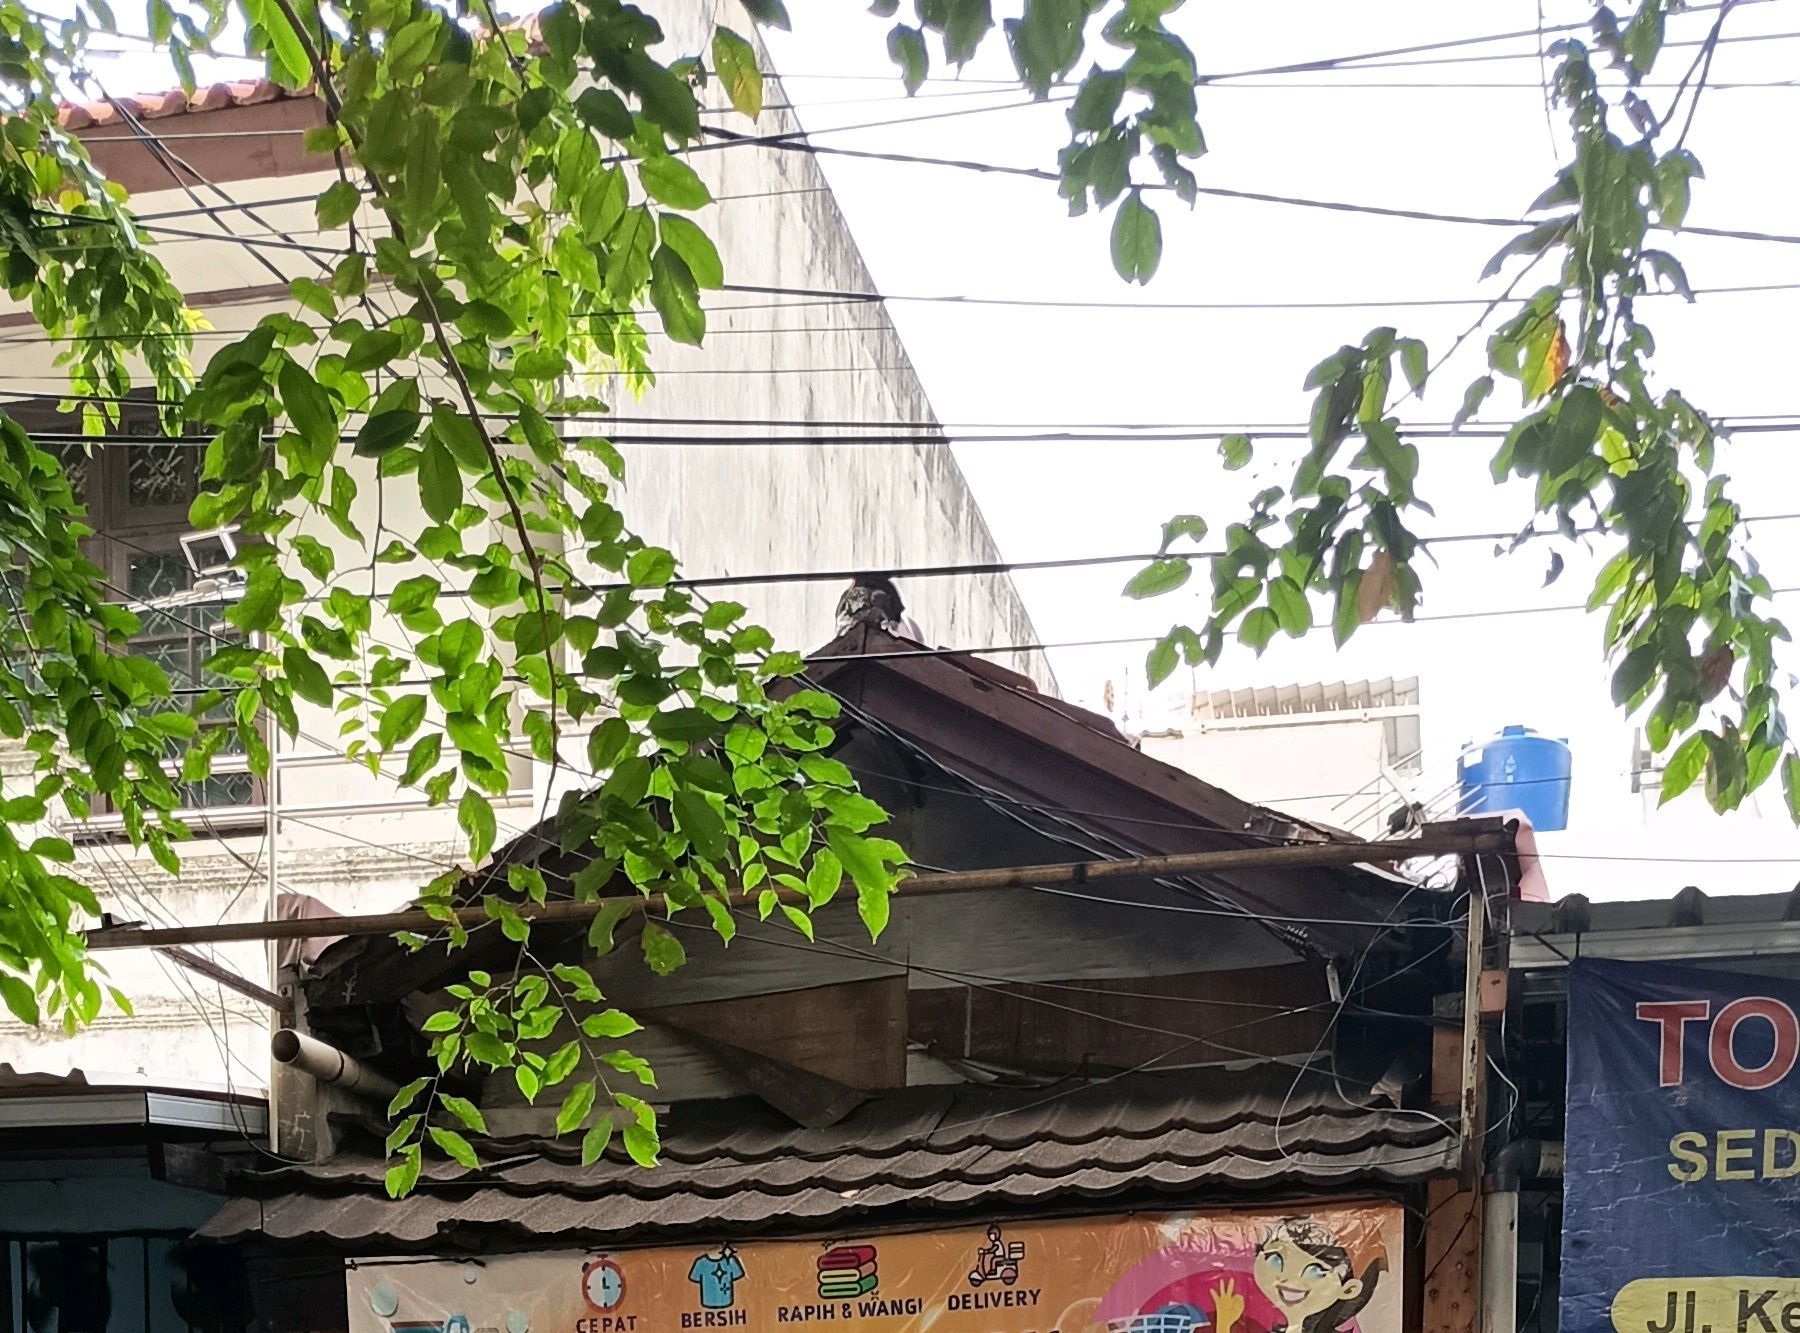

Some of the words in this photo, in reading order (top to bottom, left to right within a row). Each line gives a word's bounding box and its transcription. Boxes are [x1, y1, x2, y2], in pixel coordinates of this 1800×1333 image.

[778, 1302, 835, 1322] RAPIH
[841, 1305, 852, 1319] &
[858, 1297, 923, 1317] WANGI
[948, 1289, 1042, 1311] DELIVERY
[681, 1309, 747, 1329] BERSIH
